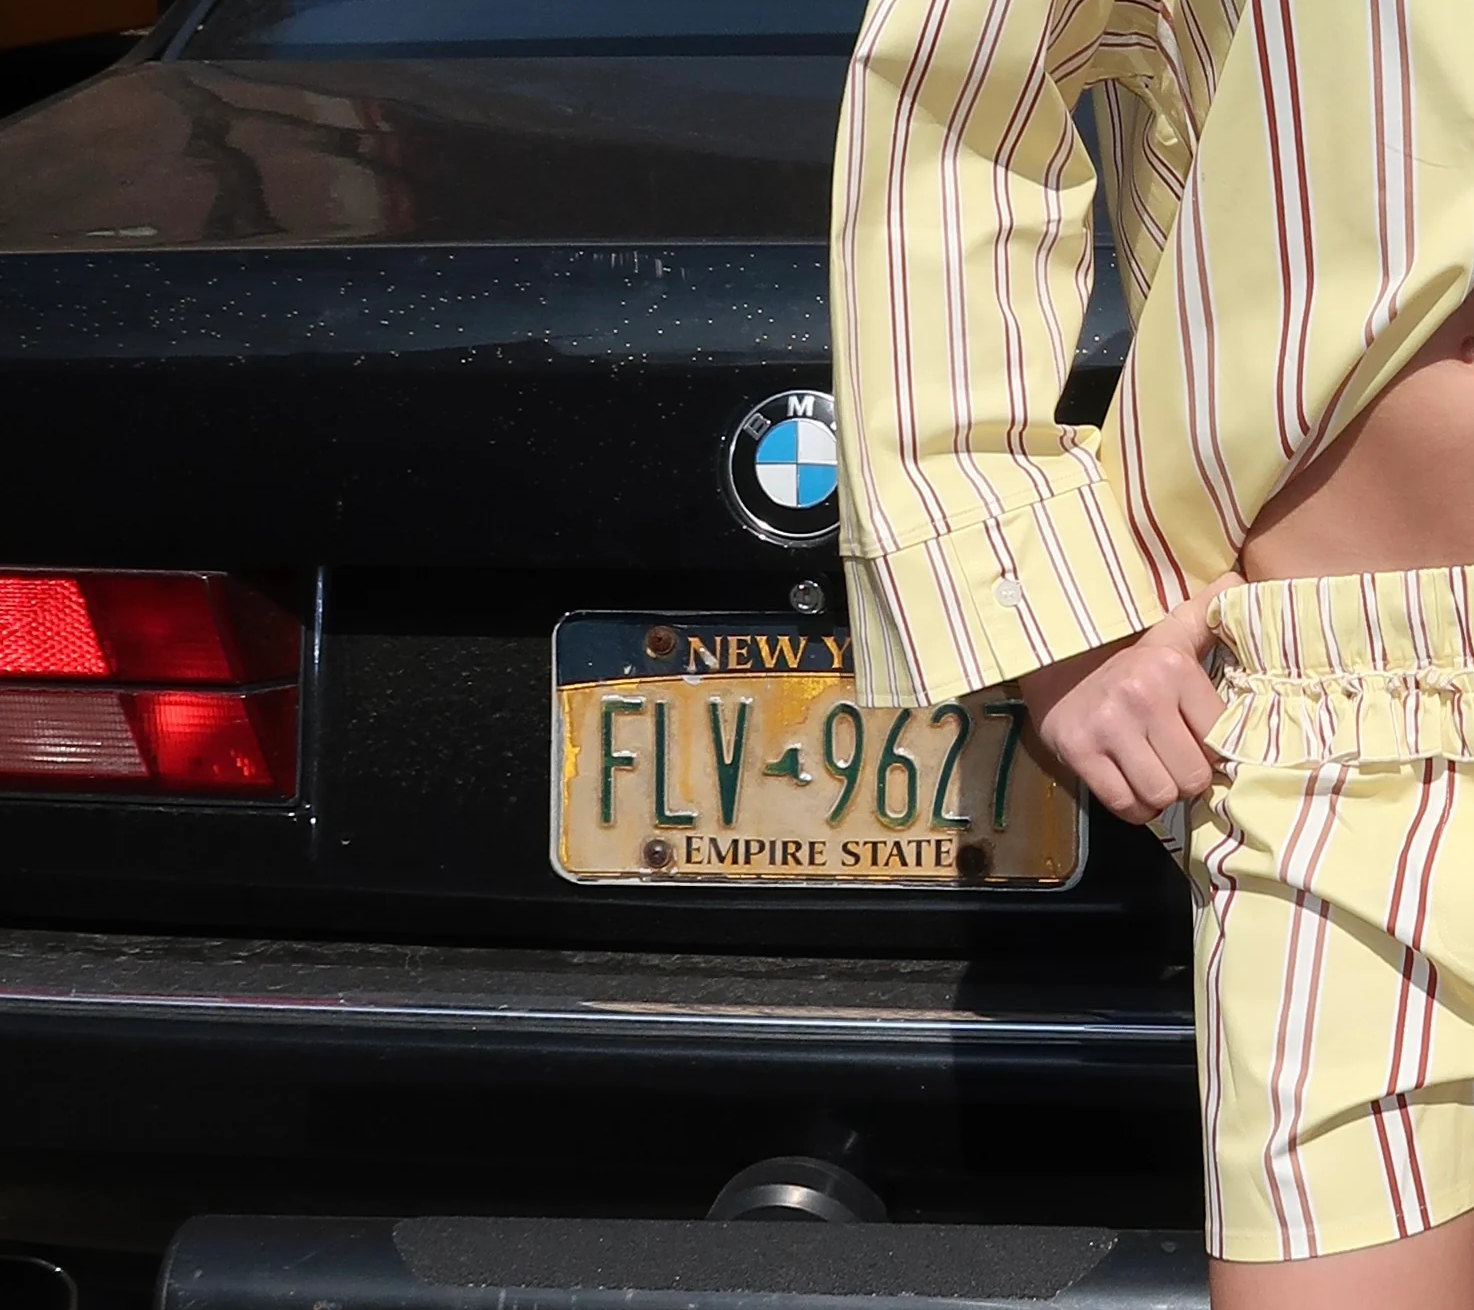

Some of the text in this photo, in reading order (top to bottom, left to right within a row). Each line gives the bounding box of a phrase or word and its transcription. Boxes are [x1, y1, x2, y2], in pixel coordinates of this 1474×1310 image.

[743, 394, 837, 441] BM
[686, 634, 808, 672] NEW
[600, 695, 1026, 830] FLV 9627
[684, 835, 957, 867] EMPIRE STATE
